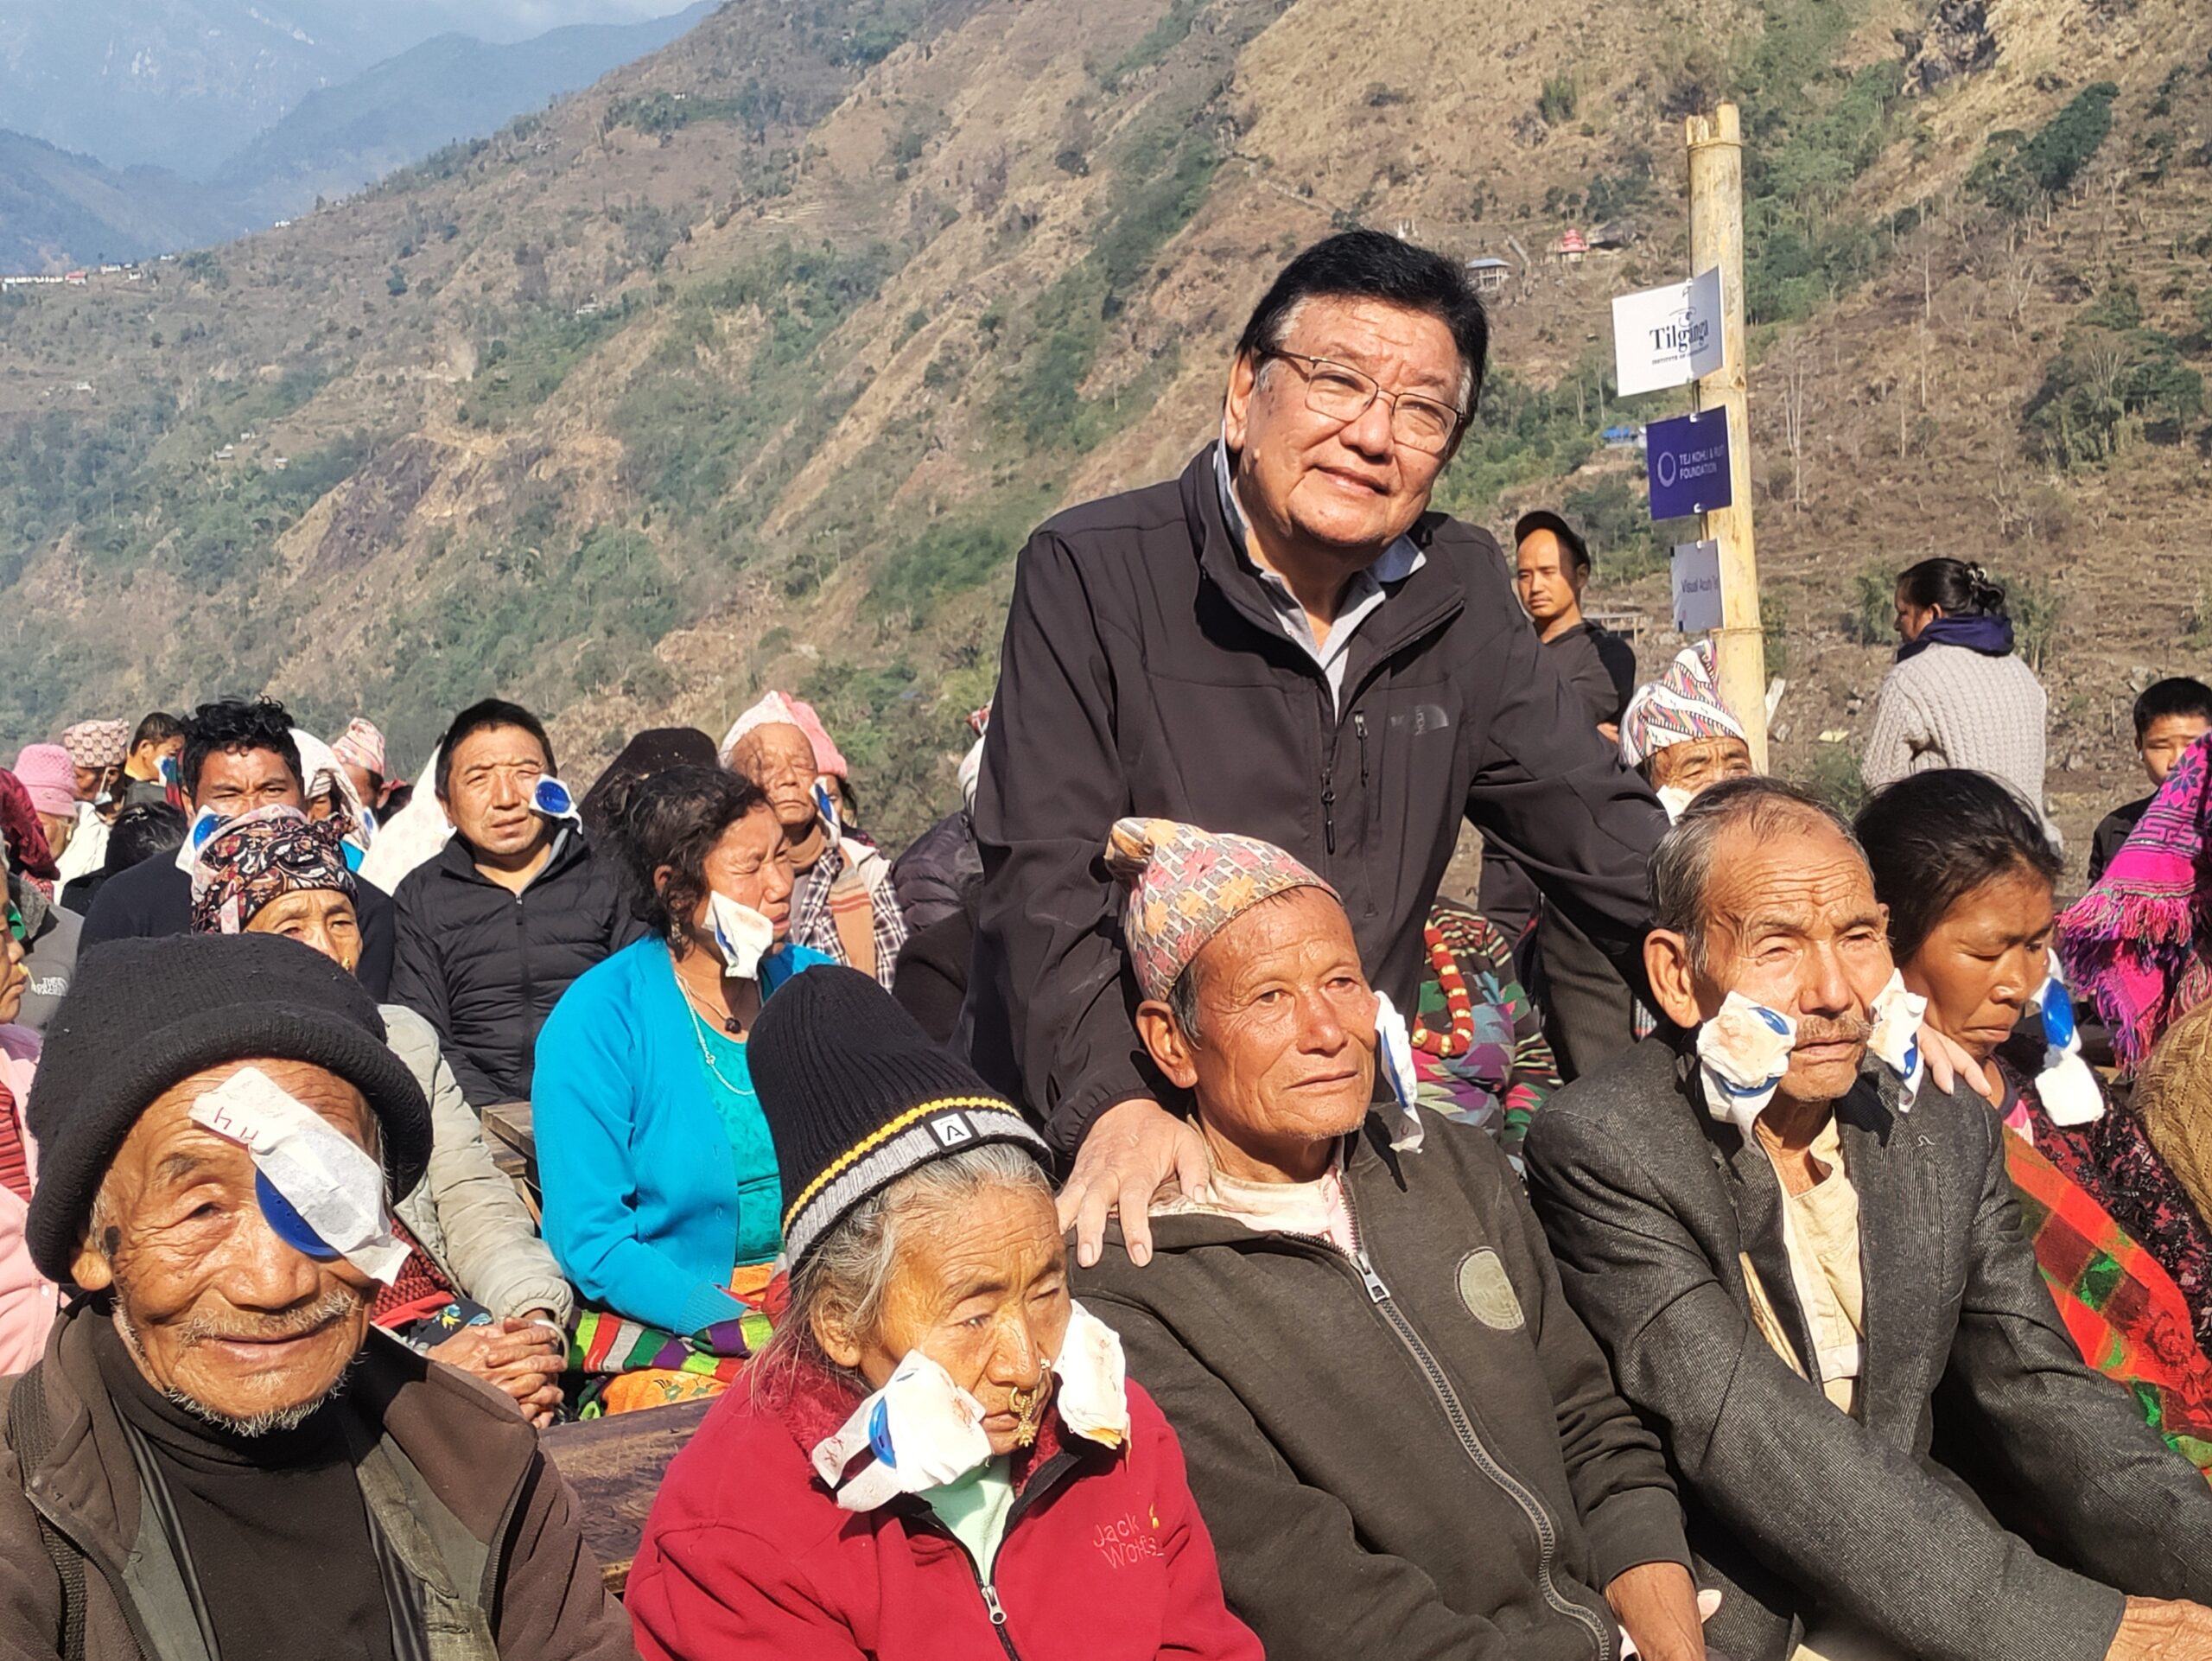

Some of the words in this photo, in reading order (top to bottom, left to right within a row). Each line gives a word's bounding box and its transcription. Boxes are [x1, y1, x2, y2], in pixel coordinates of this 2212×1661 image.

[1679, 454, 1691, 465] TEJ
[1680, 462, 1717, 480] FOUNDATION
[1092, 1511, 1141, 1549] Jack
